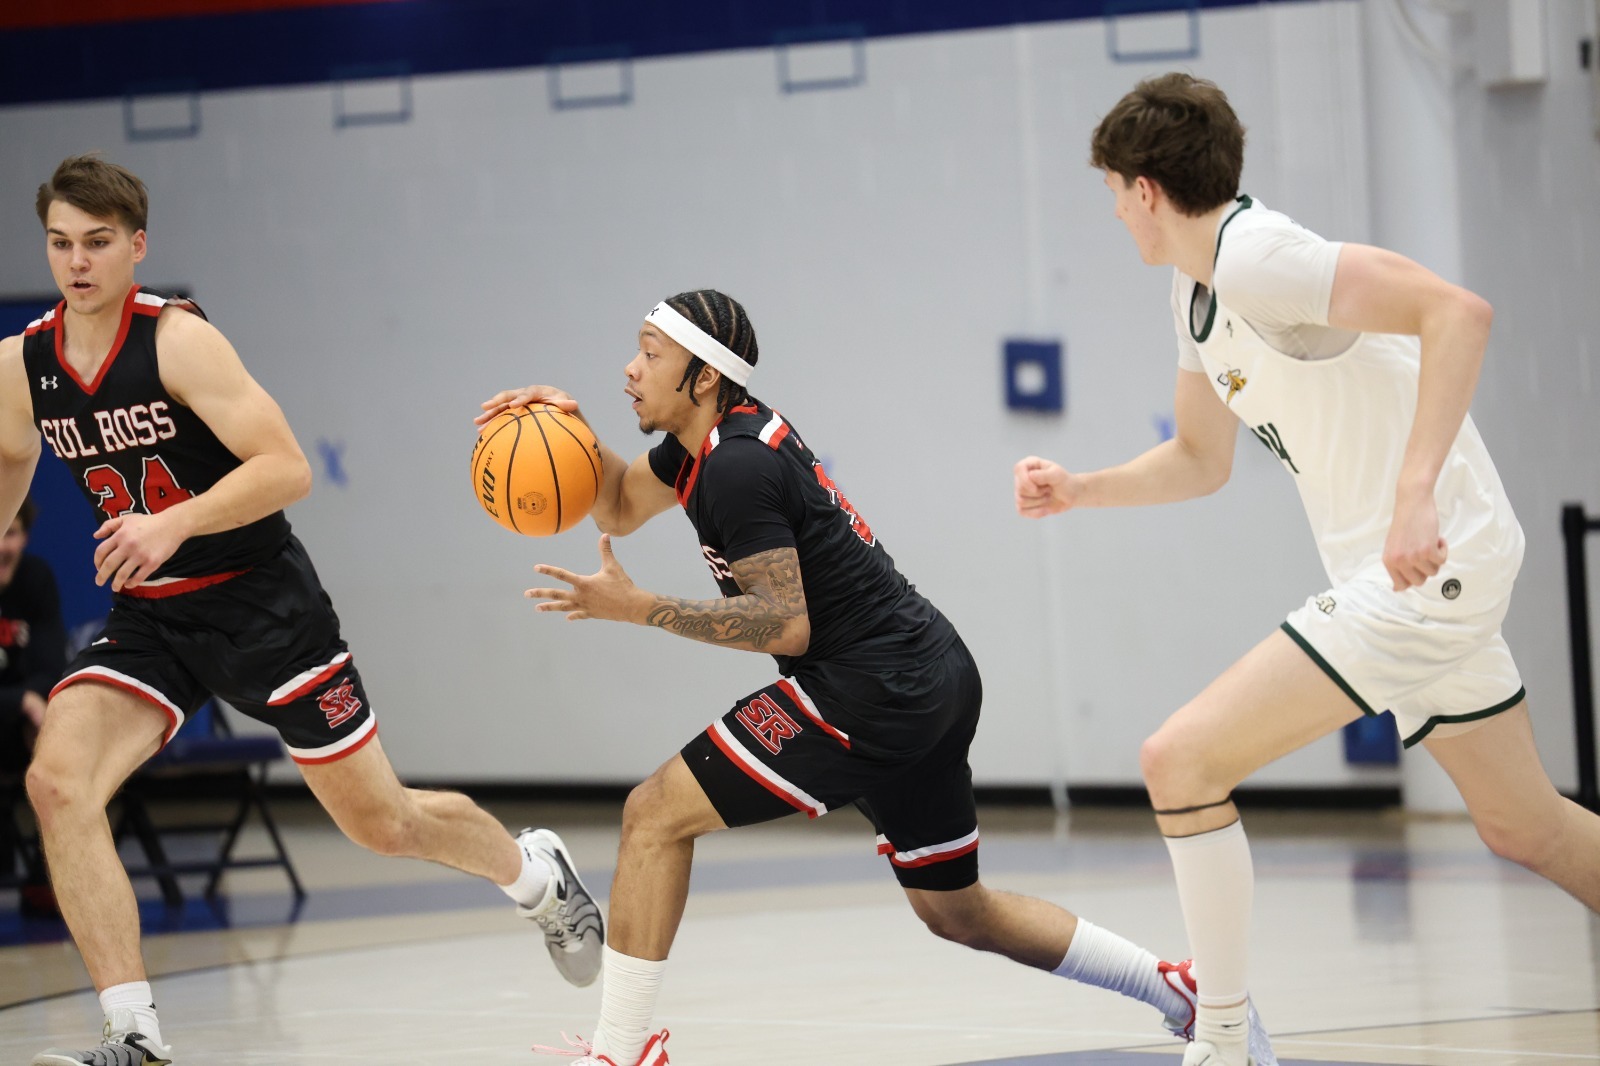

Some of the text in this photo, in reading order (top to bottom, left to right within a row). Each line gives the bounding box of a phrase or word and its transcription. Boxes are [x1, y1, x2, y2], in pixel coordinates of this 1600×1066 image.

[41, 400, 177, 459] SUL ROSS
[83, 454, 196, 520] 24
[482, 467, 500, 519] EVO
[317, 679, 361, 727] SR
[737, 694, 800, 753] SR
